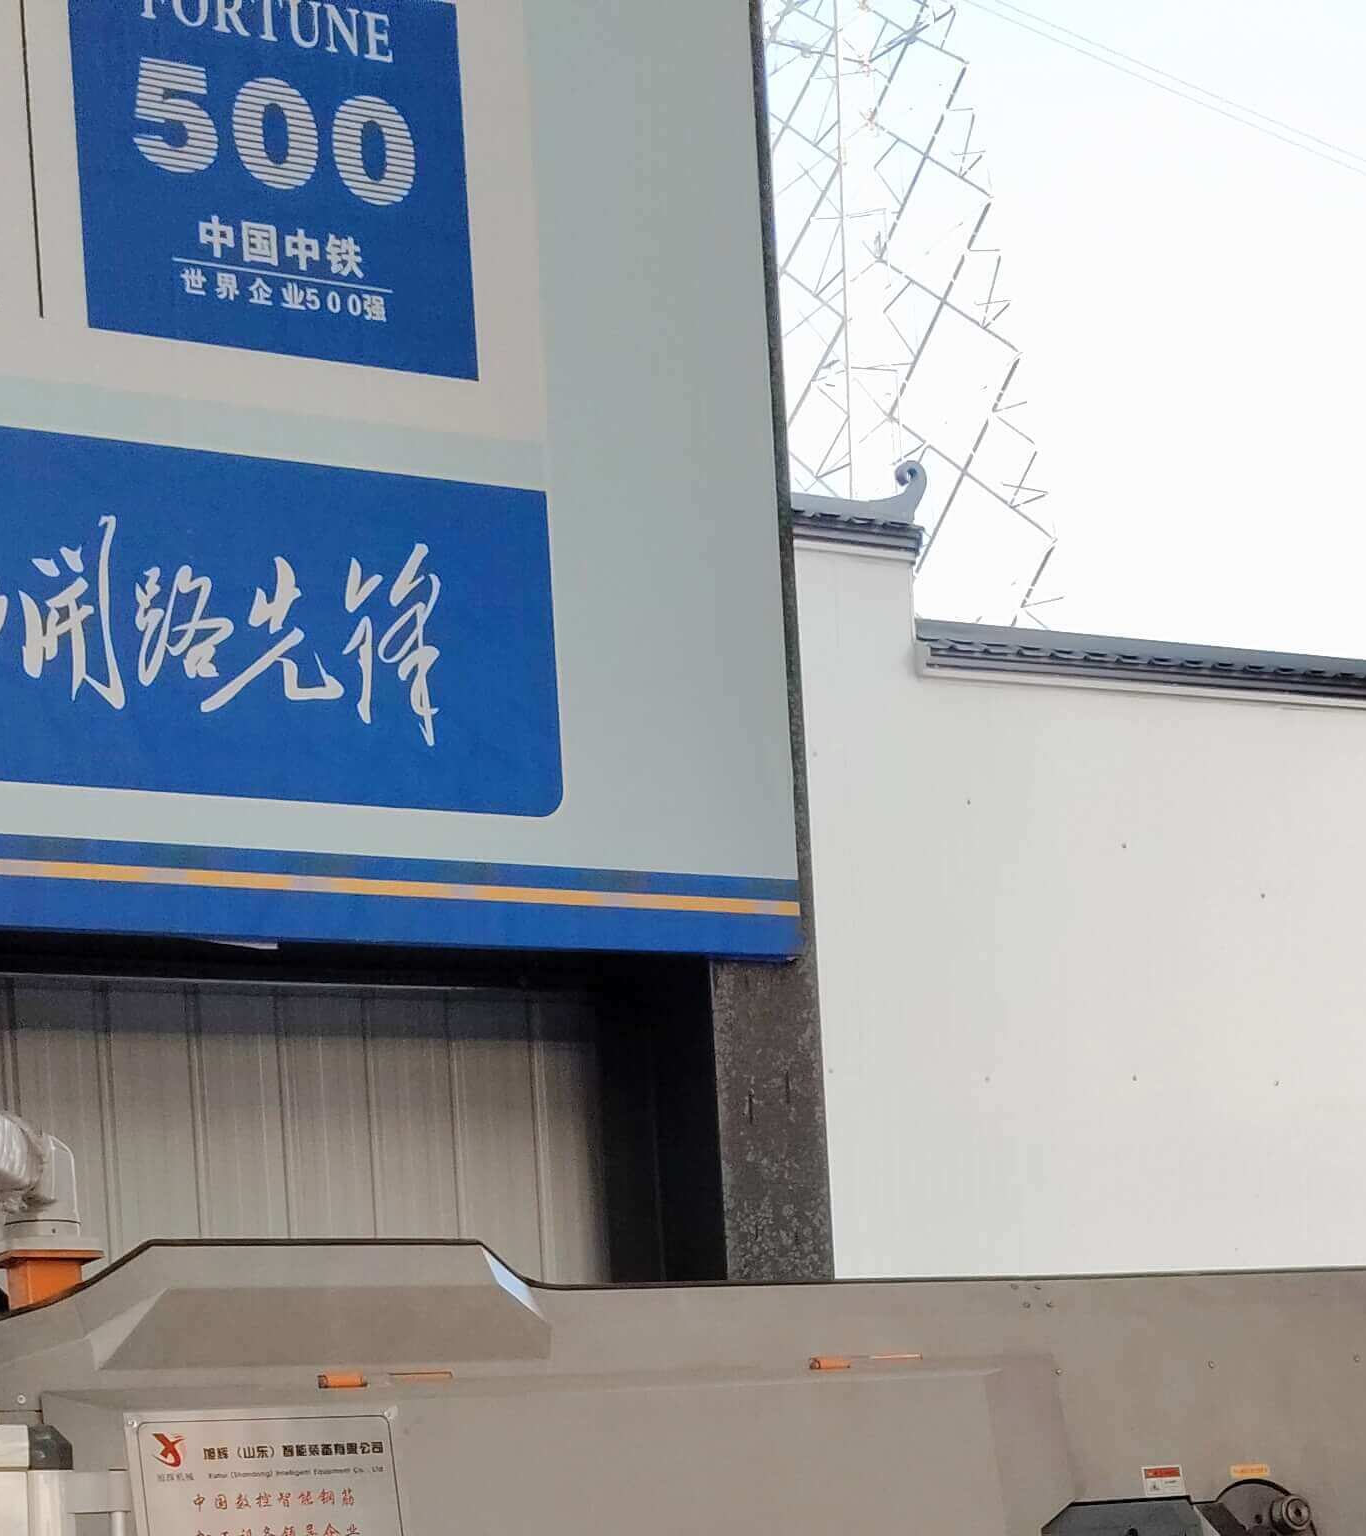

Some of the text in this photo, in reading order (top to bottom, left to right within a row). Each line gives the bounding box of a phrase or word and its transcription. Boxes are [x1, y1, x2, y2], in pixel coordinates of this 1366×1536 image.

[133, 56, 416, 206] 500
[198, 214, 364, 279] 中国中铁
